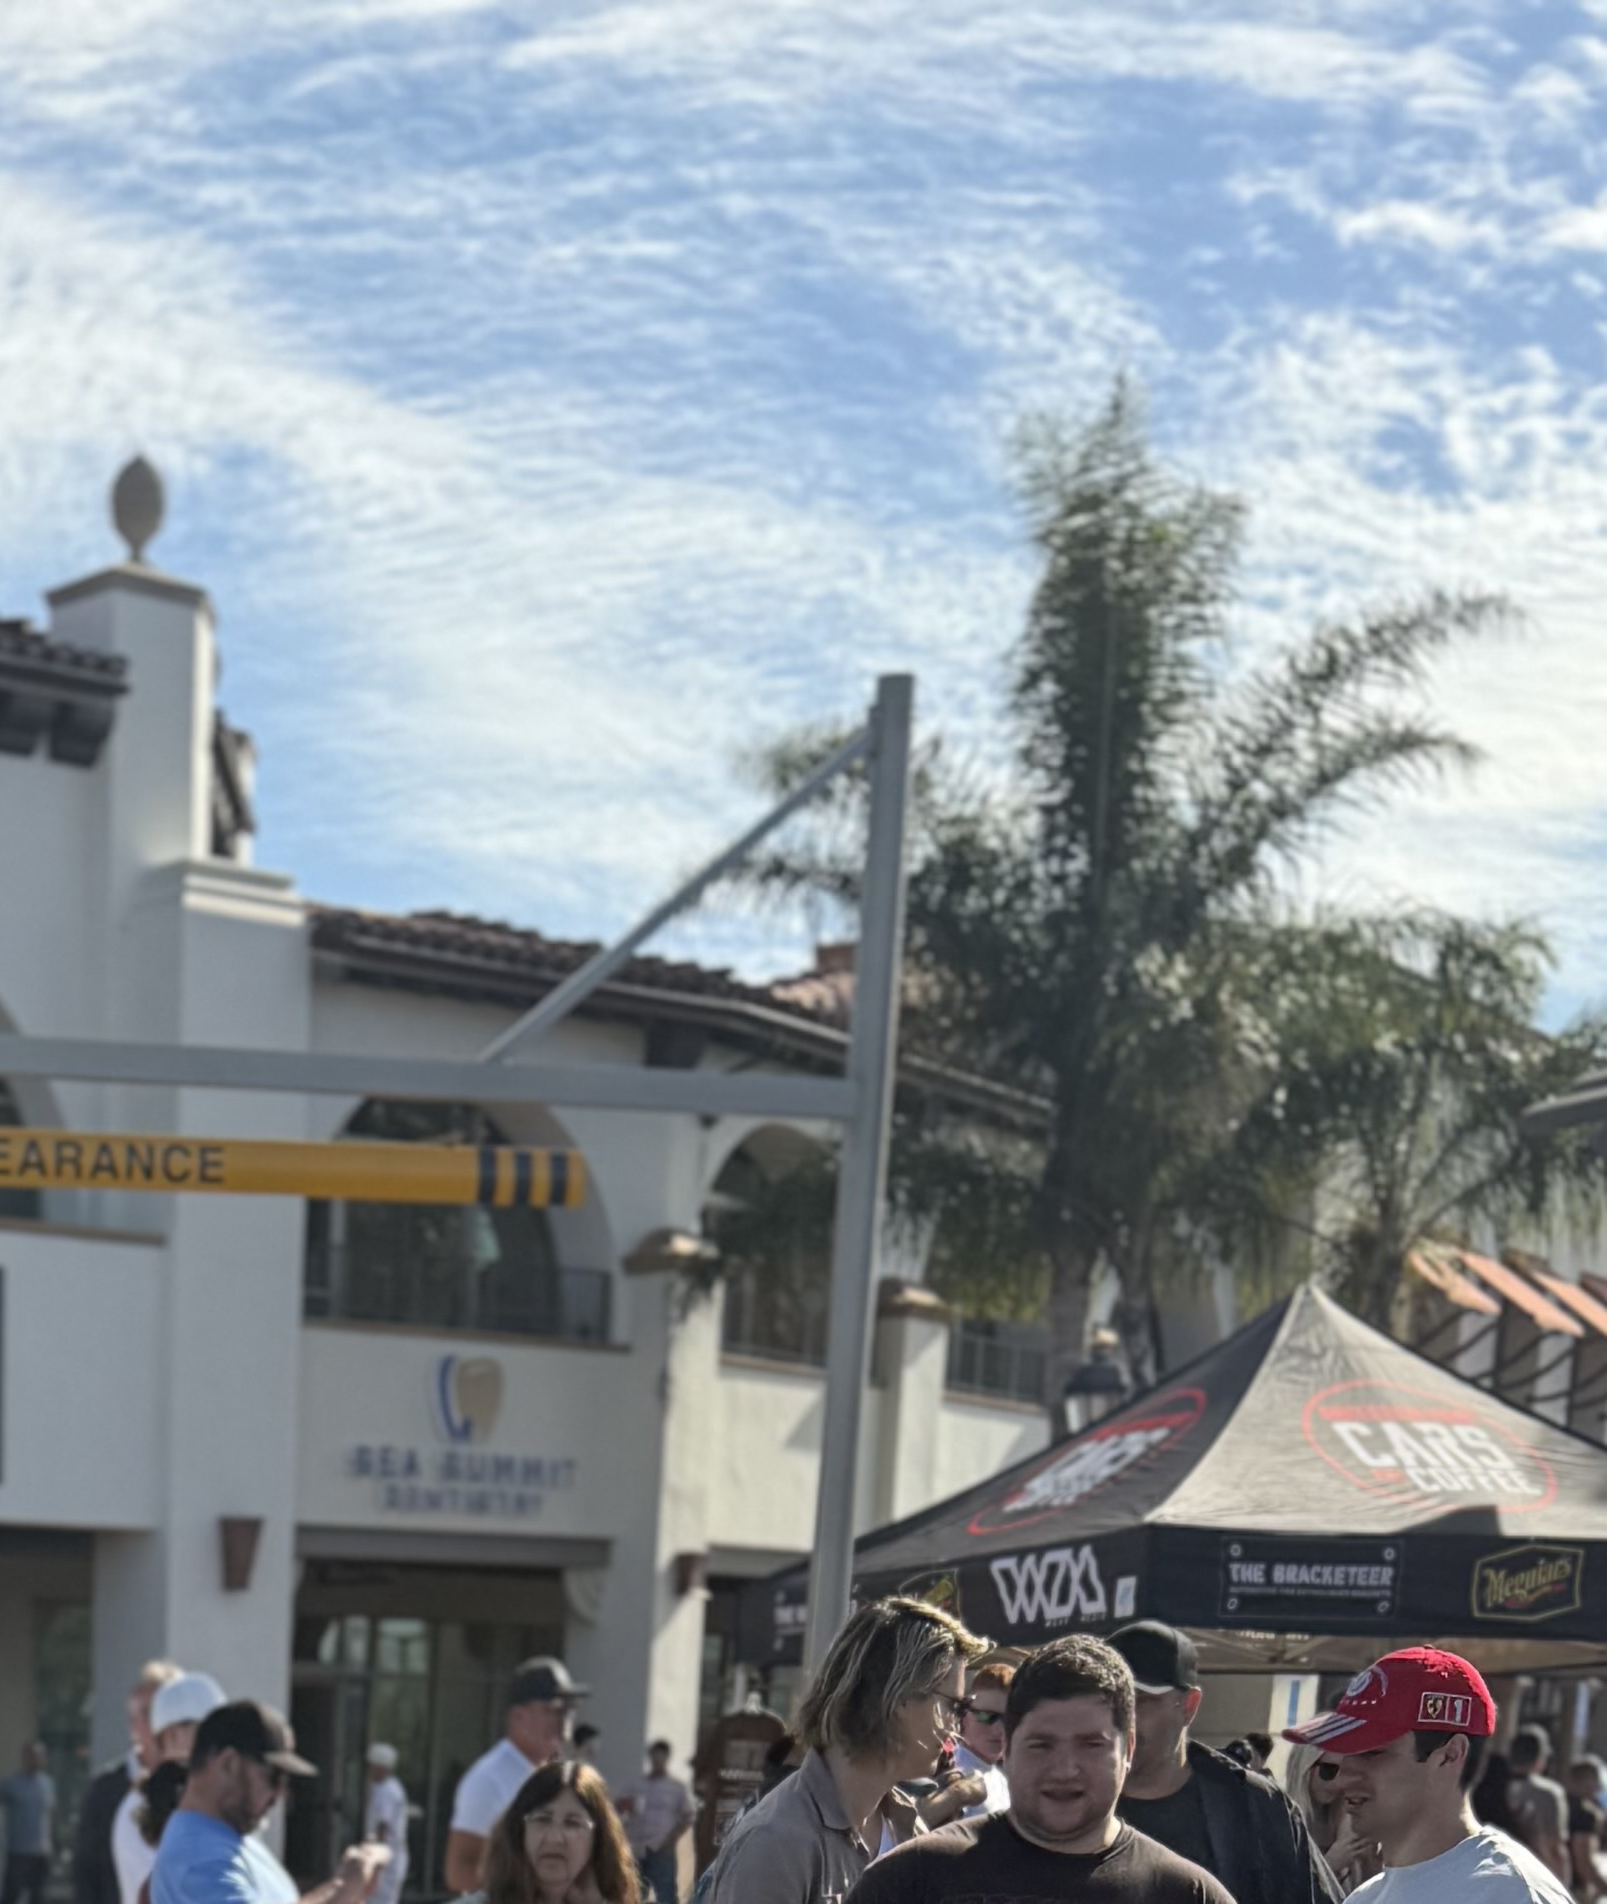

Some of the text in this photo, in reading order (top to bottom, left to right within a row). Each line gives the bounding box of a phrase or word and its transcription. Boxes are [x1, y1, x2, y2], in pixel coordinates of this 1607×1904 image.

[1331, 1421, 1518, 1468] CARS
[1404, 1467, 1543, 1496] COFFEE
[1229, 1563, 1393, 1586] THE BRACKETEER
